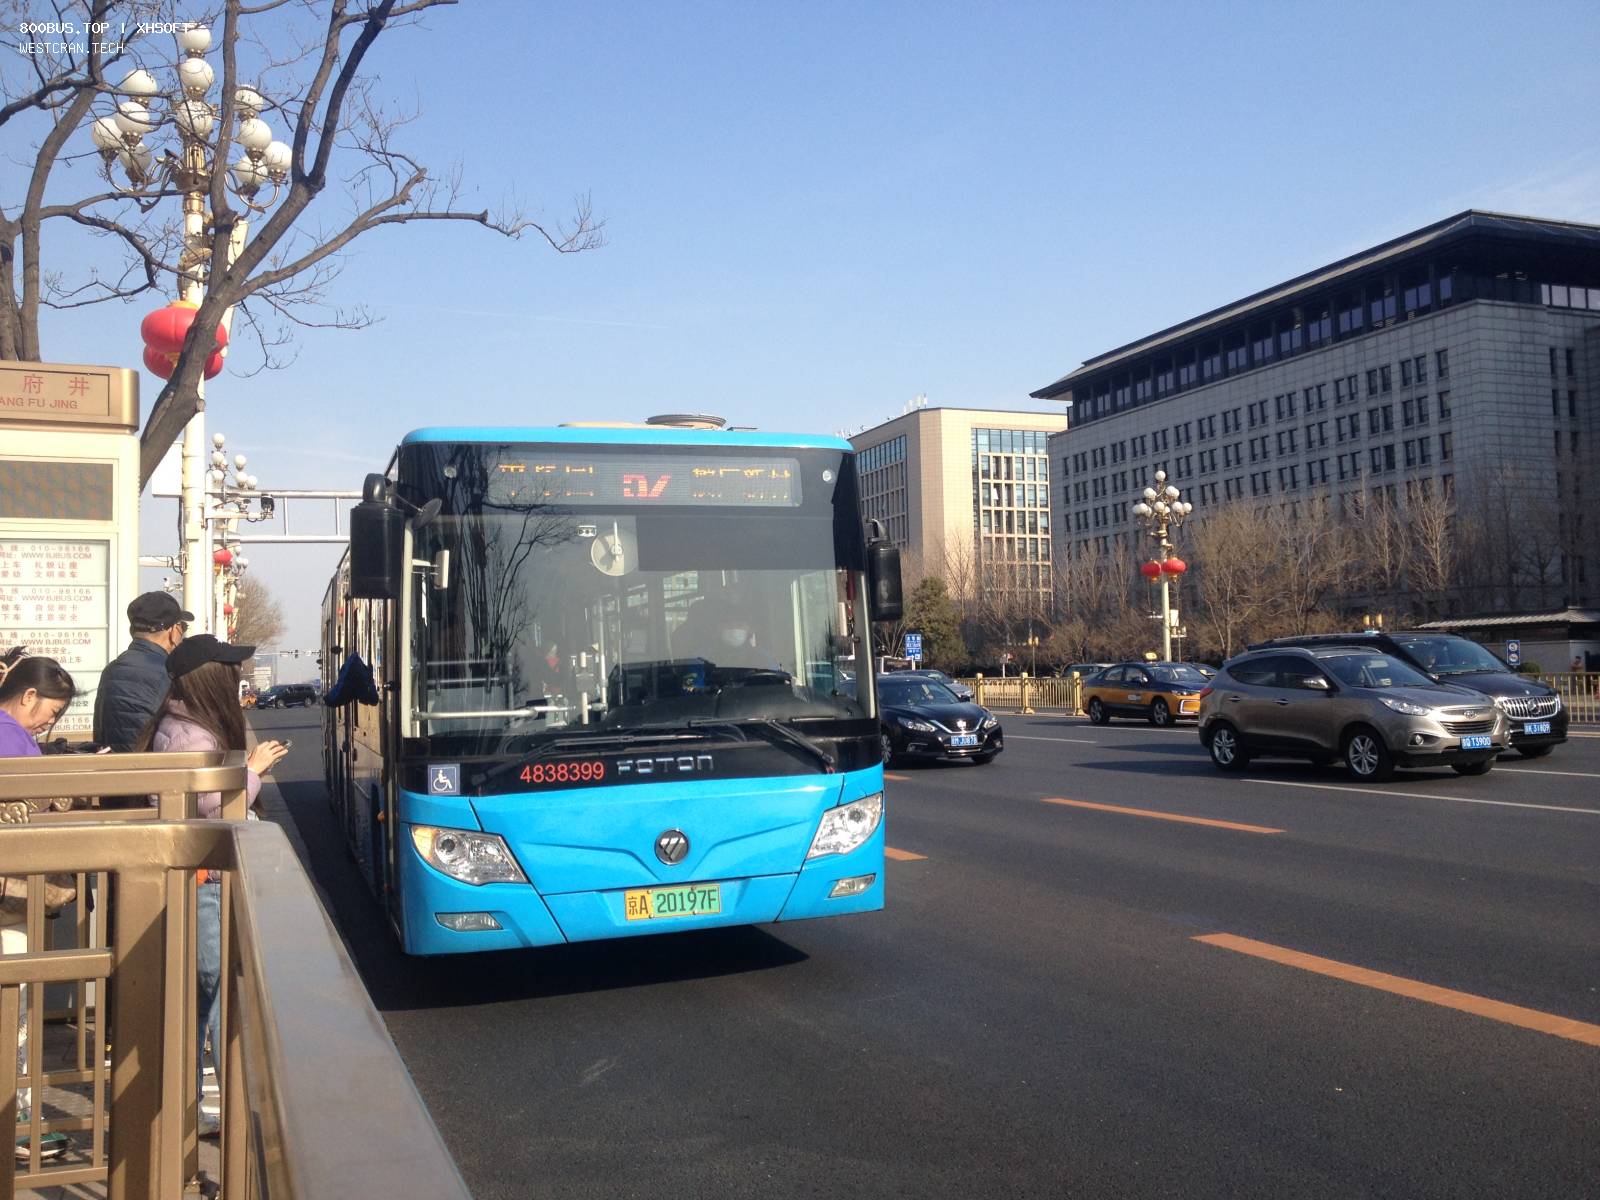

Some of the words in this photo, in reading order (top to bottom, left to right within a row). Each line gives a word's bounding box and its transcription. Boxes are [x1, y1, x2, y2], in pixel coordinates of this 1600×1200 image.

[22, 373, 91, 397] 府井
[28, 397, 46, 408] FU
[49, 399, 79, 410] JING
[519, 761, 605, 784] 4838399
